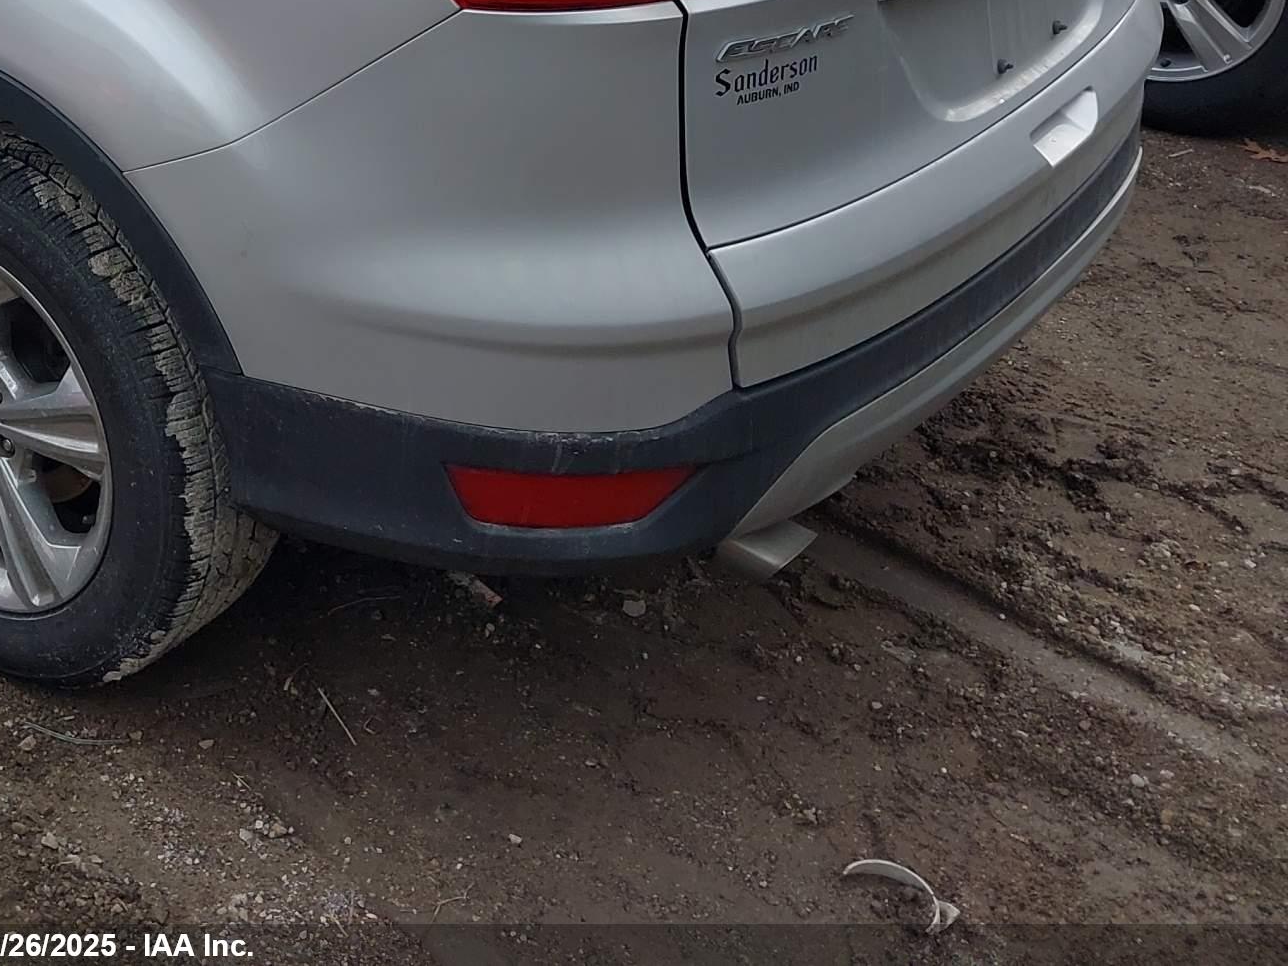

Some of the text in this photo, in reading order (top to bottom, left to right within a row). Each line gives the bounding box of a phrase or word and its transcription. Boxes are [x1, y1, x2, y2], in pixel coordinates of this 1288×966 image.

[715, 13, 855, 63] ESCAPE
[715, 55, 818, 97] Sanderson
[736, 81, 800, 106] AUBURN, IND
